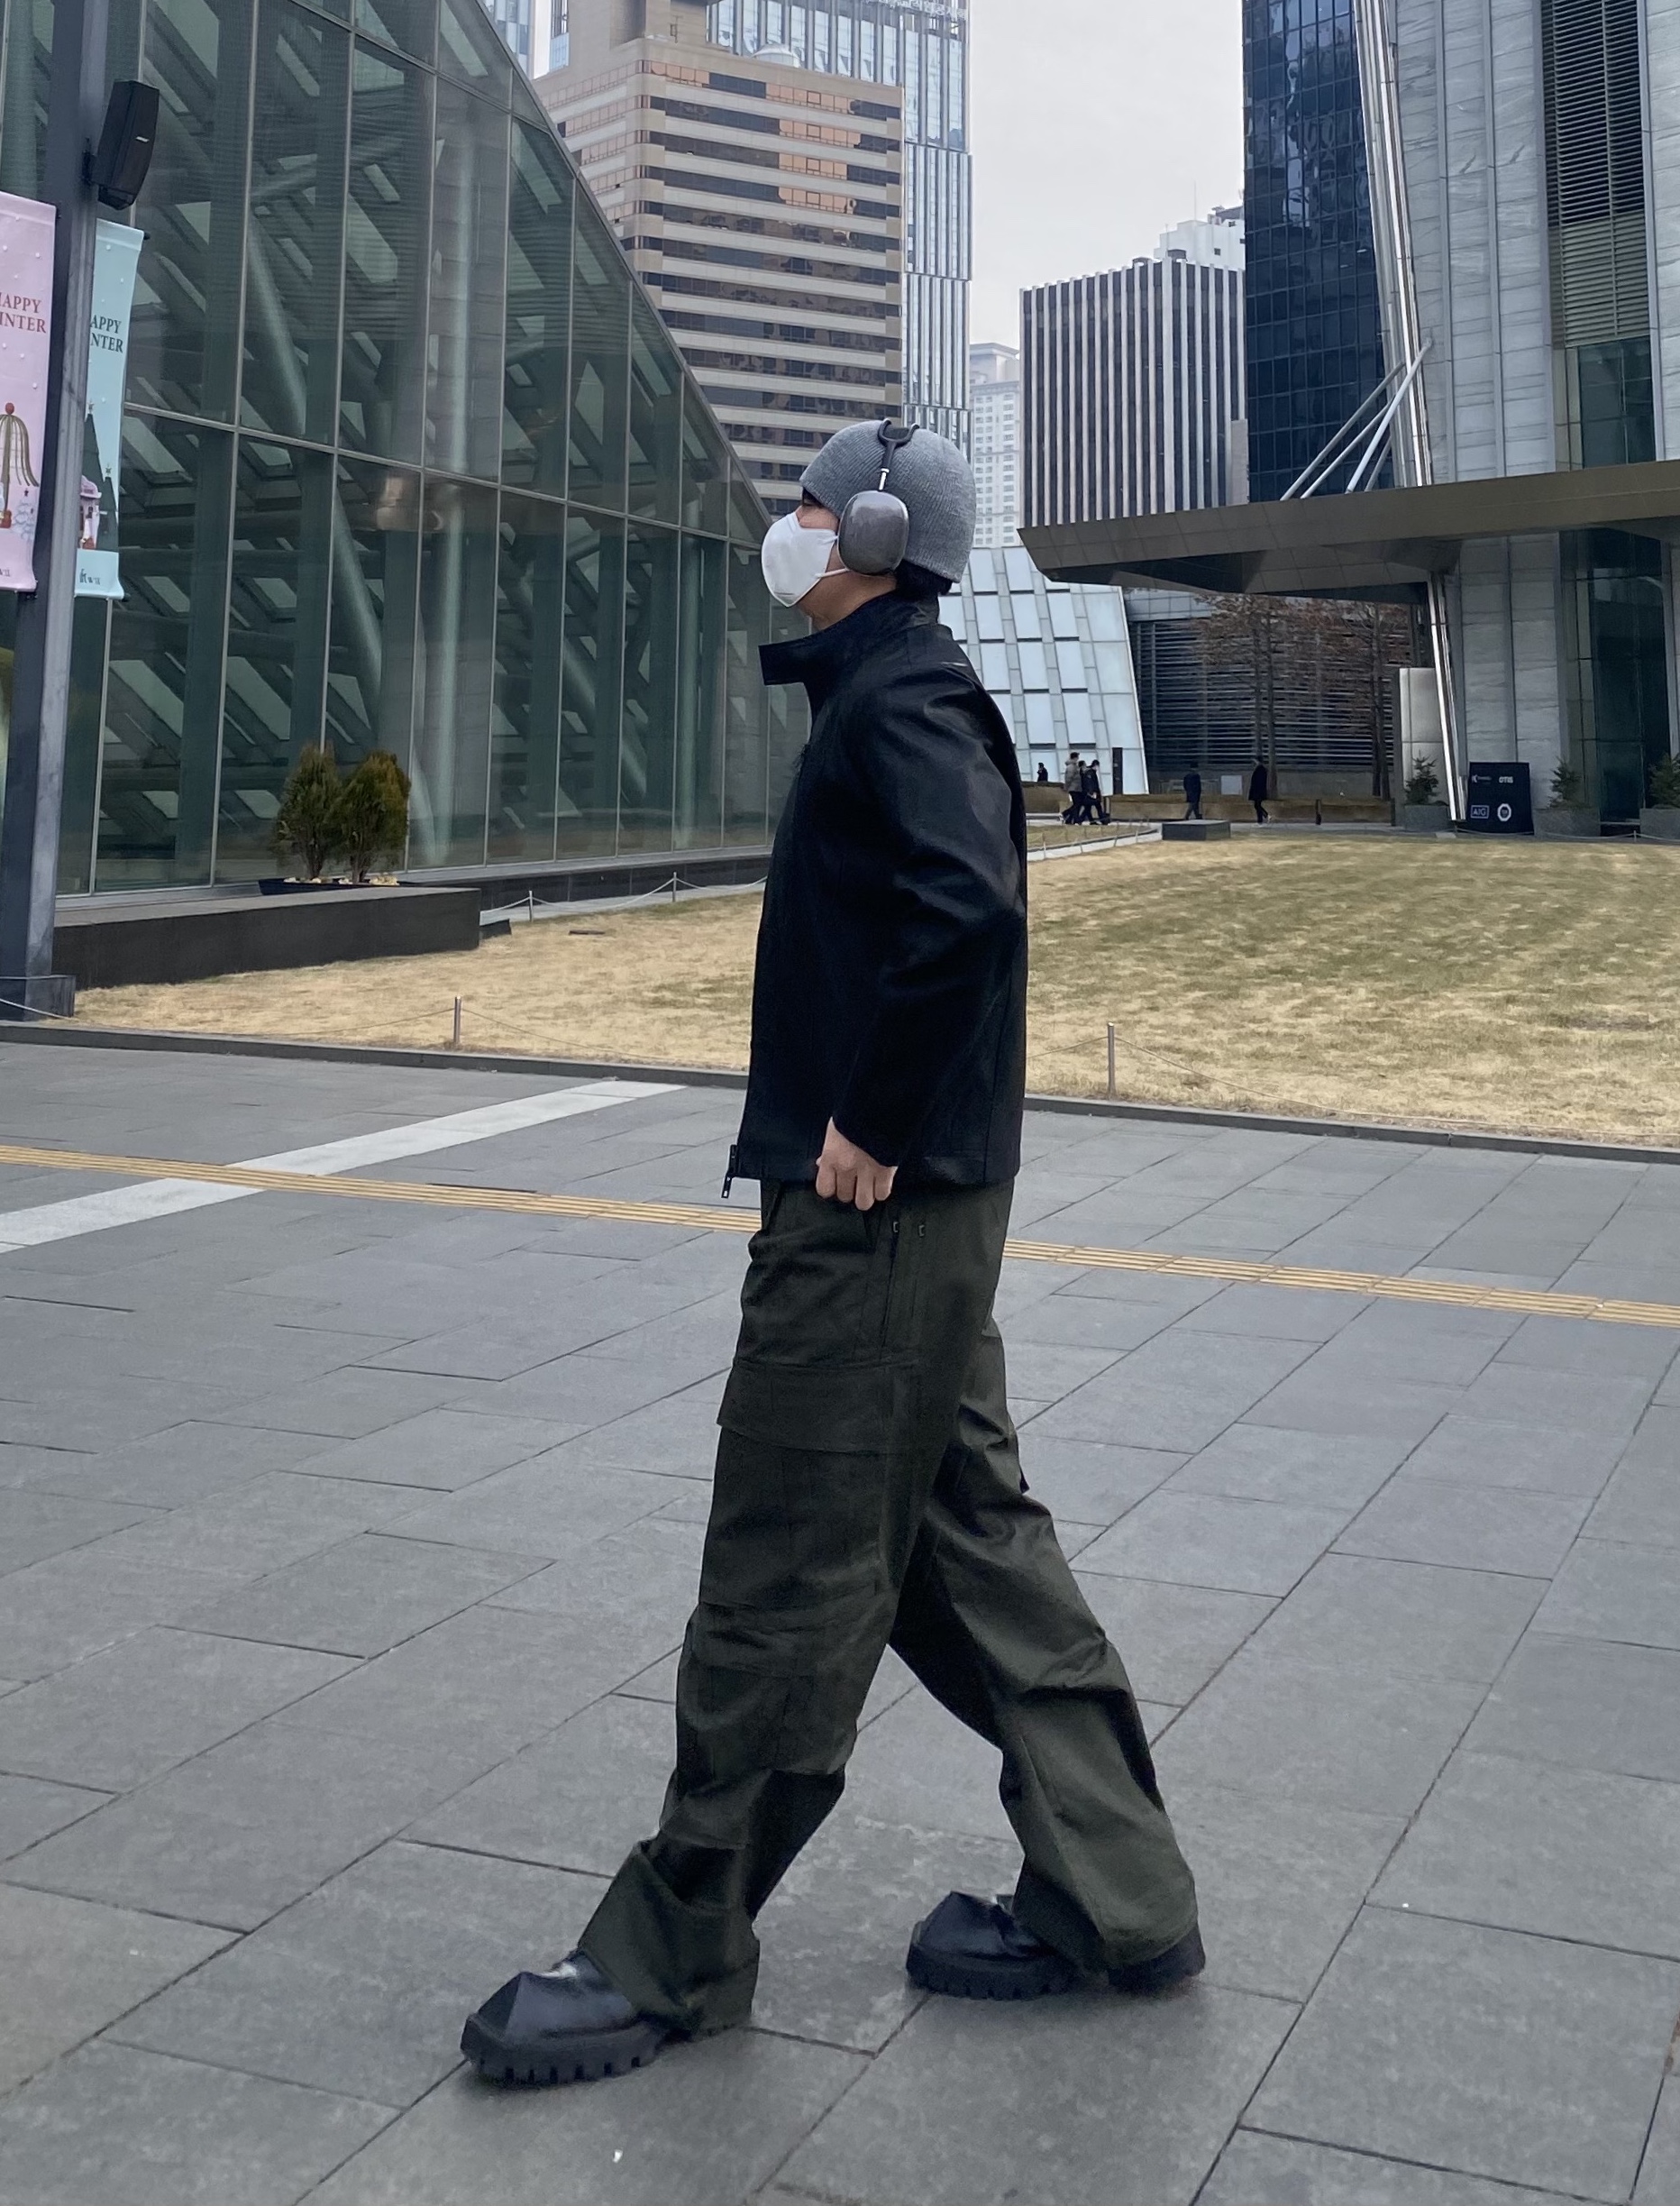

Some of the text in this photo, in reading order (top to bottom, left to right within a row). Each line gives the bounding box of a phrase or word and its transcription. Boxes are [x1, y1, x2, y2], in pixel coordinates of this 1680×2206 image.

[0, 311, 47, 334] INTER
[90, 314, 123, 334] APPY
[90, 332, 123, 353] NTER
